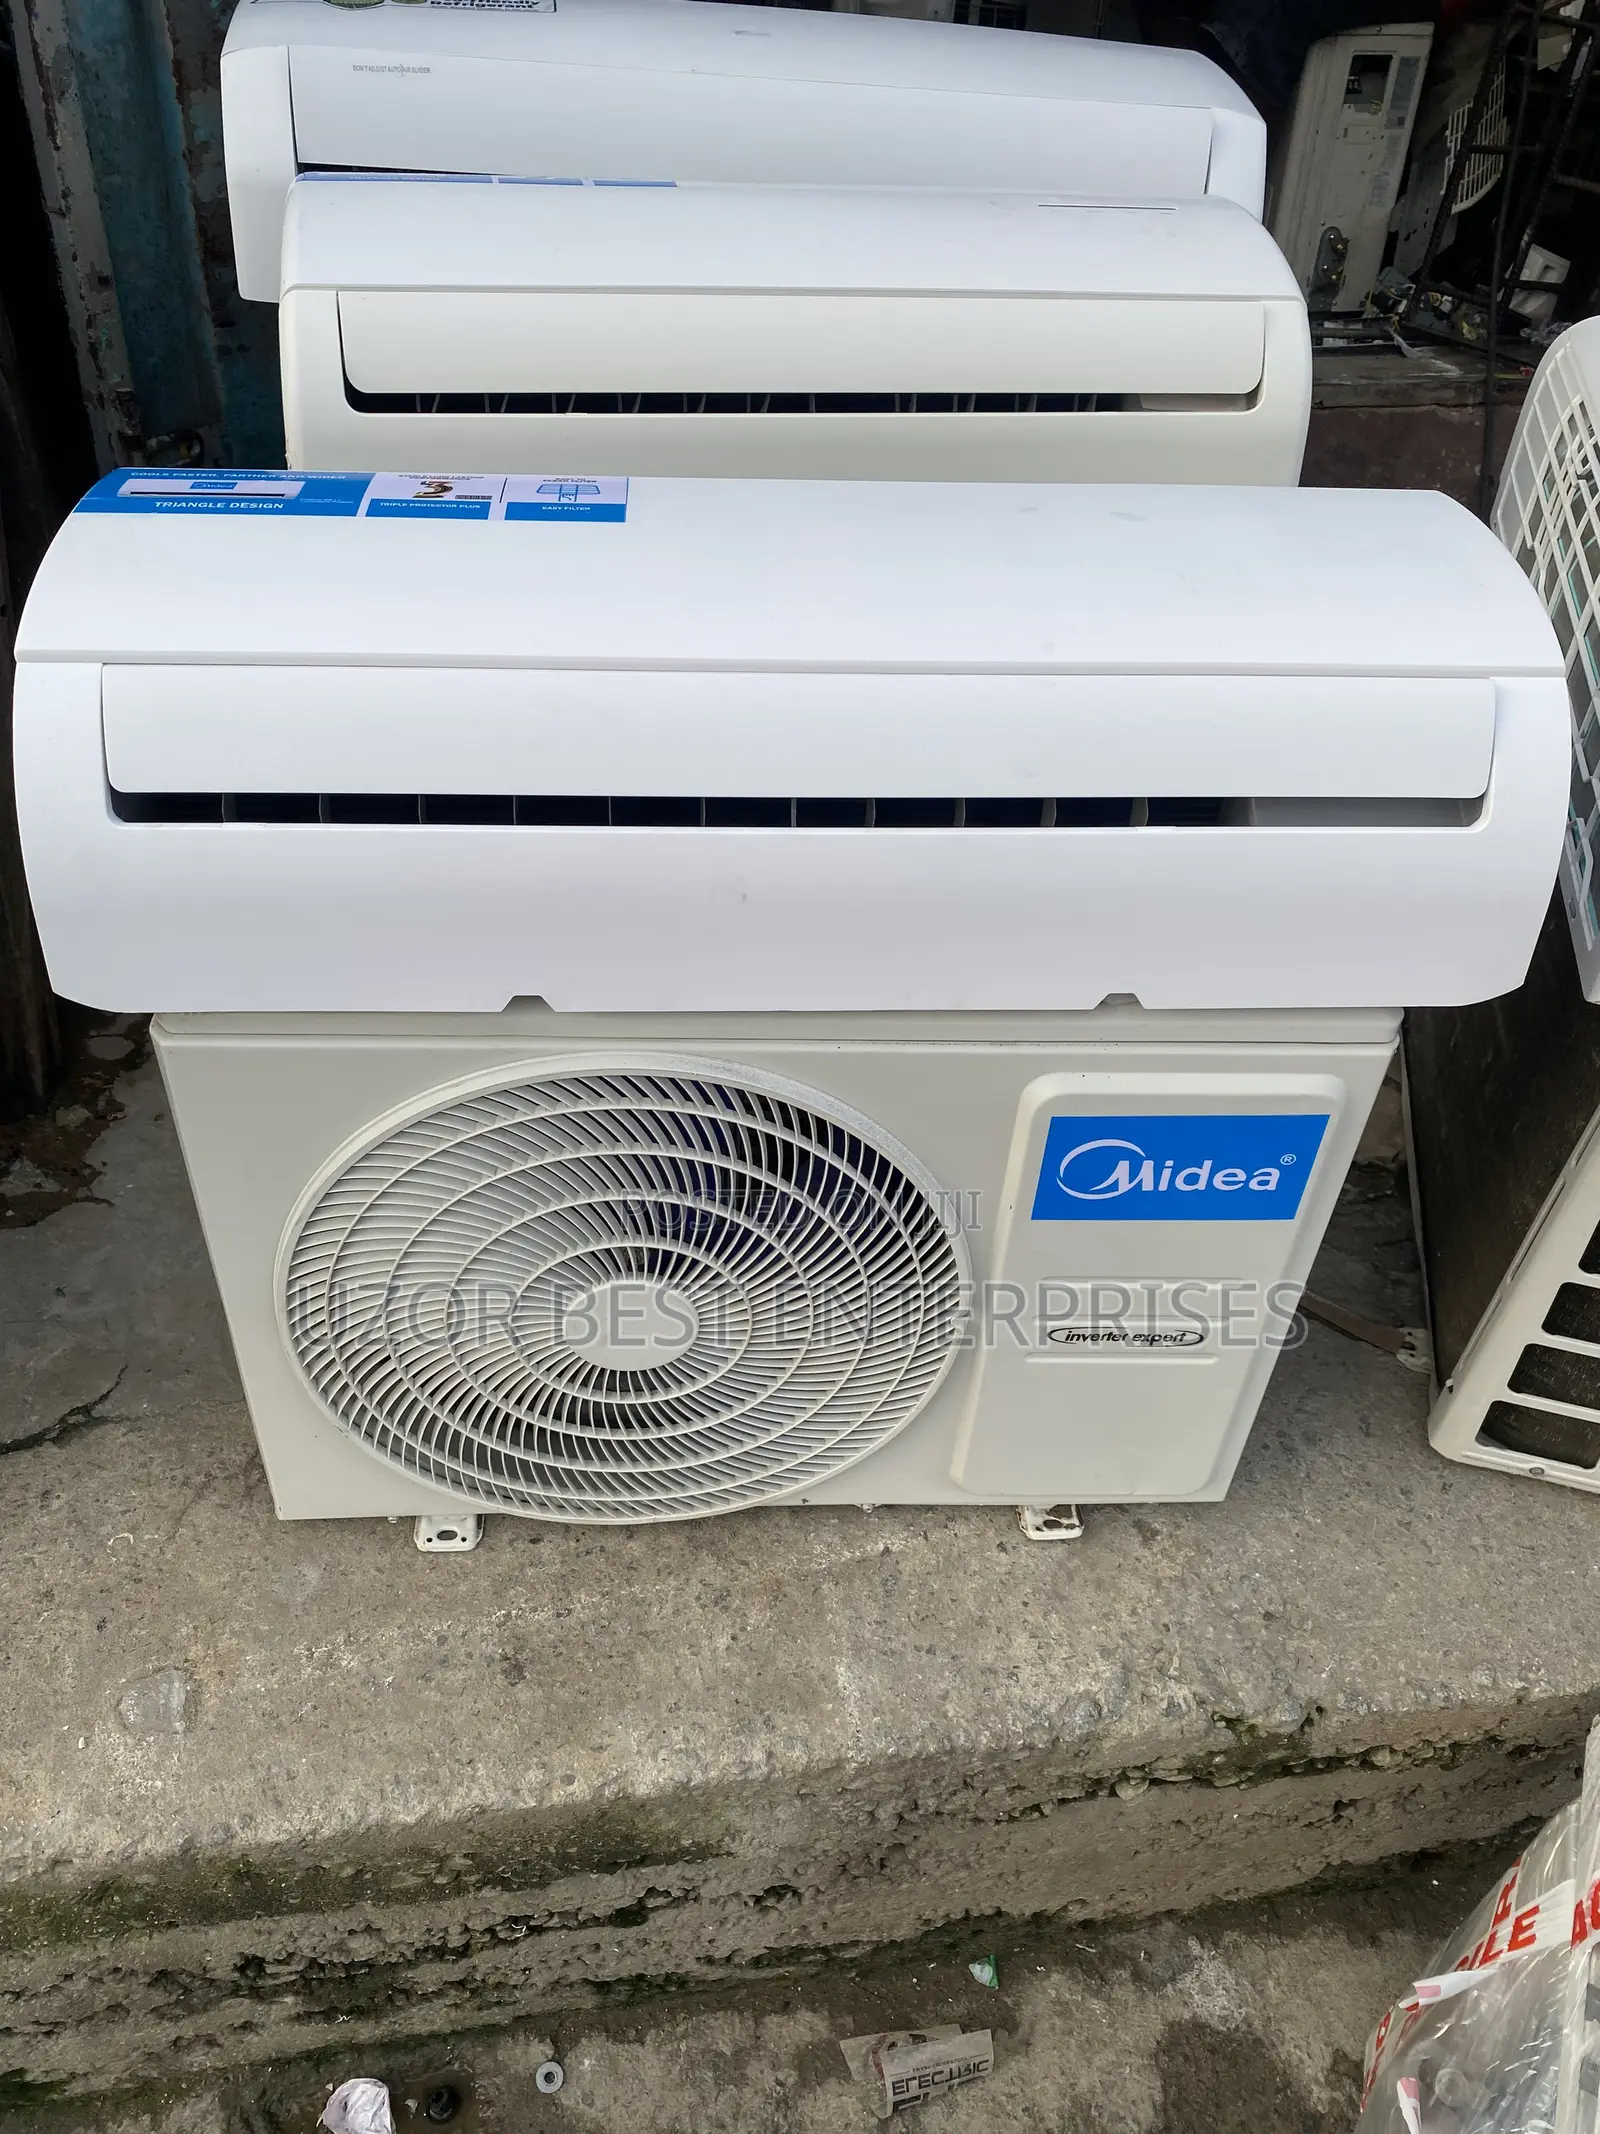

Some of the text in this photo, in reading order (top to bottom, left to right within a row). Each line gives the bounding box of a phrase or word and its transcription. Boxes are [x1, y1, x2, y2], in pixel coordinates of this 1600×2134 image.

[1056, 1138, 1282, 1200] Midea
[1064, 1329, 1187, 1347] inverter expert
